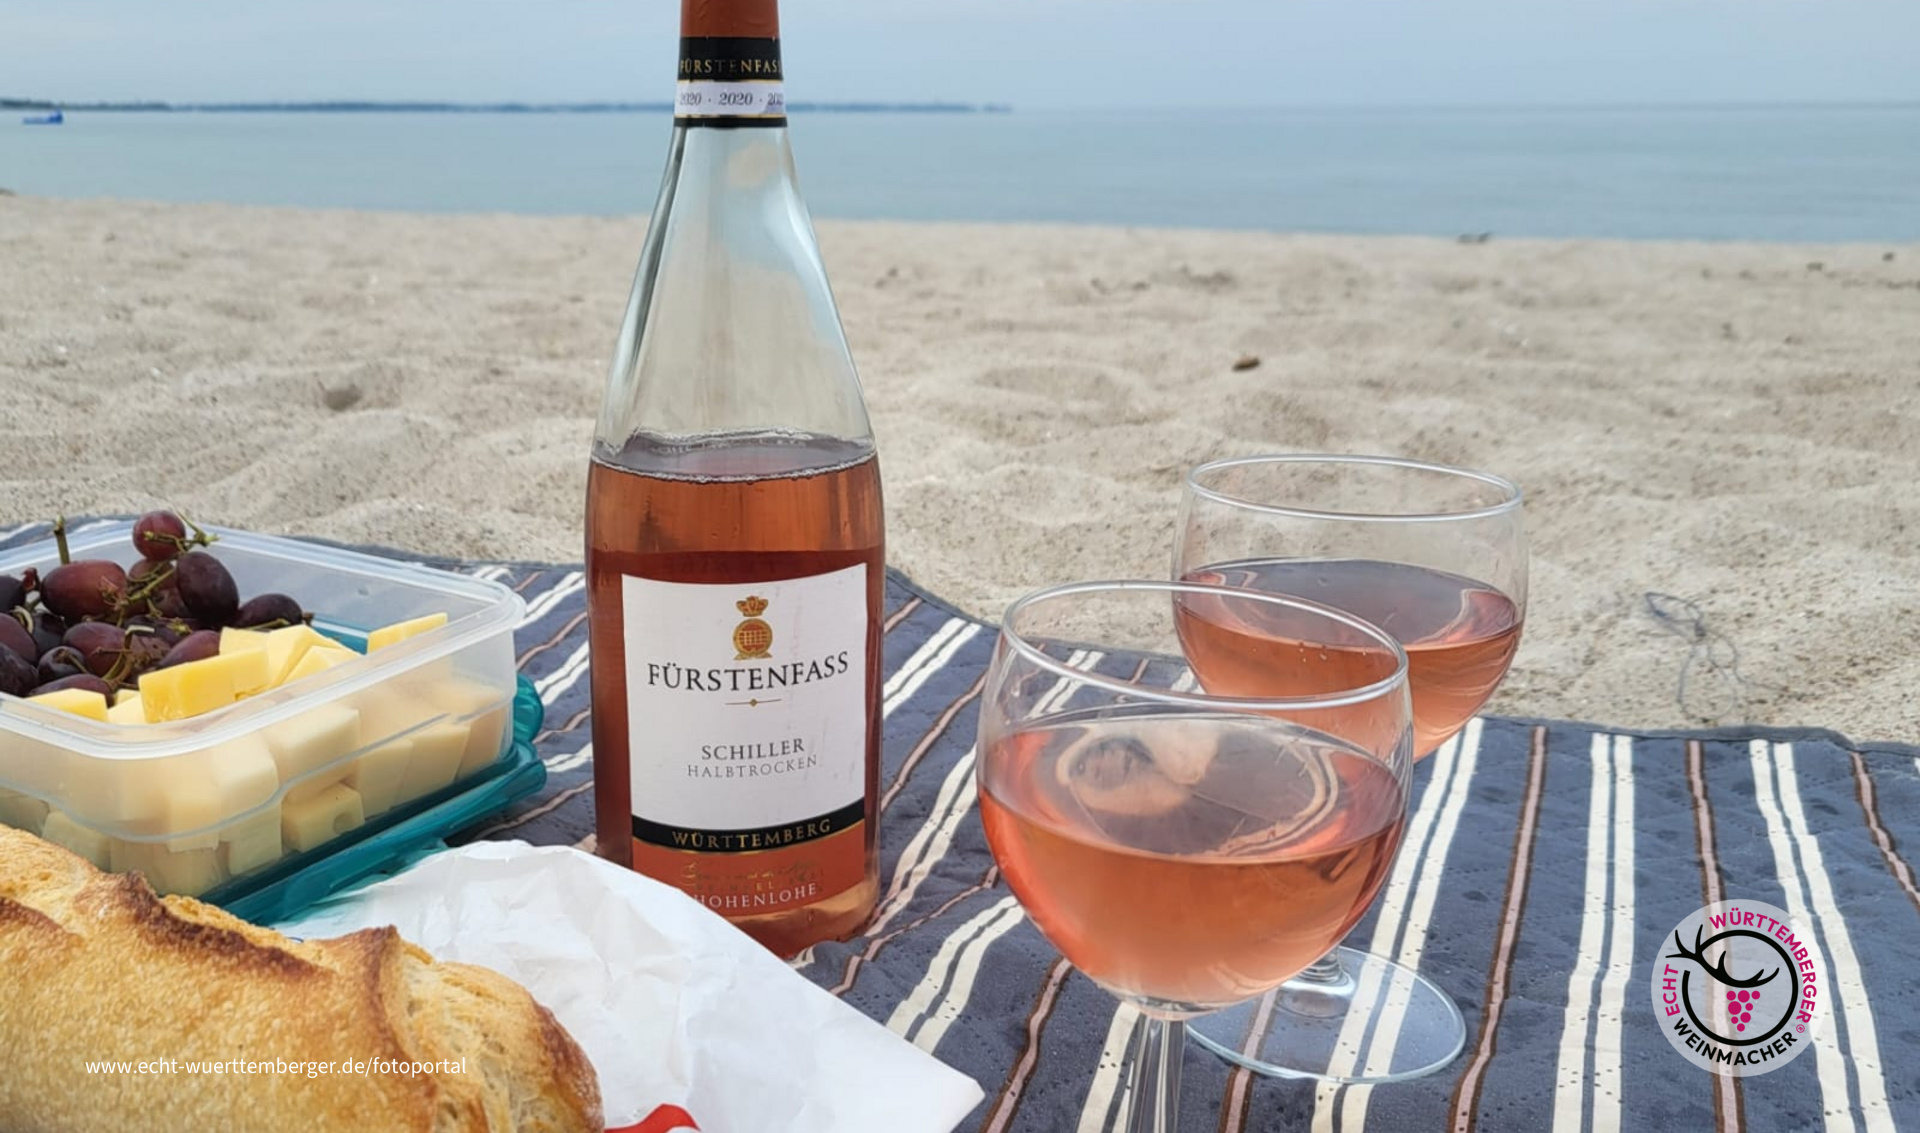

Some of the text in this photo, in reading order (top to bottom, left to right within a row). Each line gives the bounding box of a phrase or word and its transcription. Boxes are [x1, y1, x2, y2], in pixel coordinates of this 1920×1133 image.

[680, 58, 779, 73] FÜRSTENFAS
[719, 92, 753, 106] 2020
[648, 651, 849, 692] FÜRSTENFASS
[701, 738, 805, 760] SCHILLER
[687, 754, 817, 778] HALBTROCKEN
[672, 819, 831, 848] WÜRTTEMBERG
